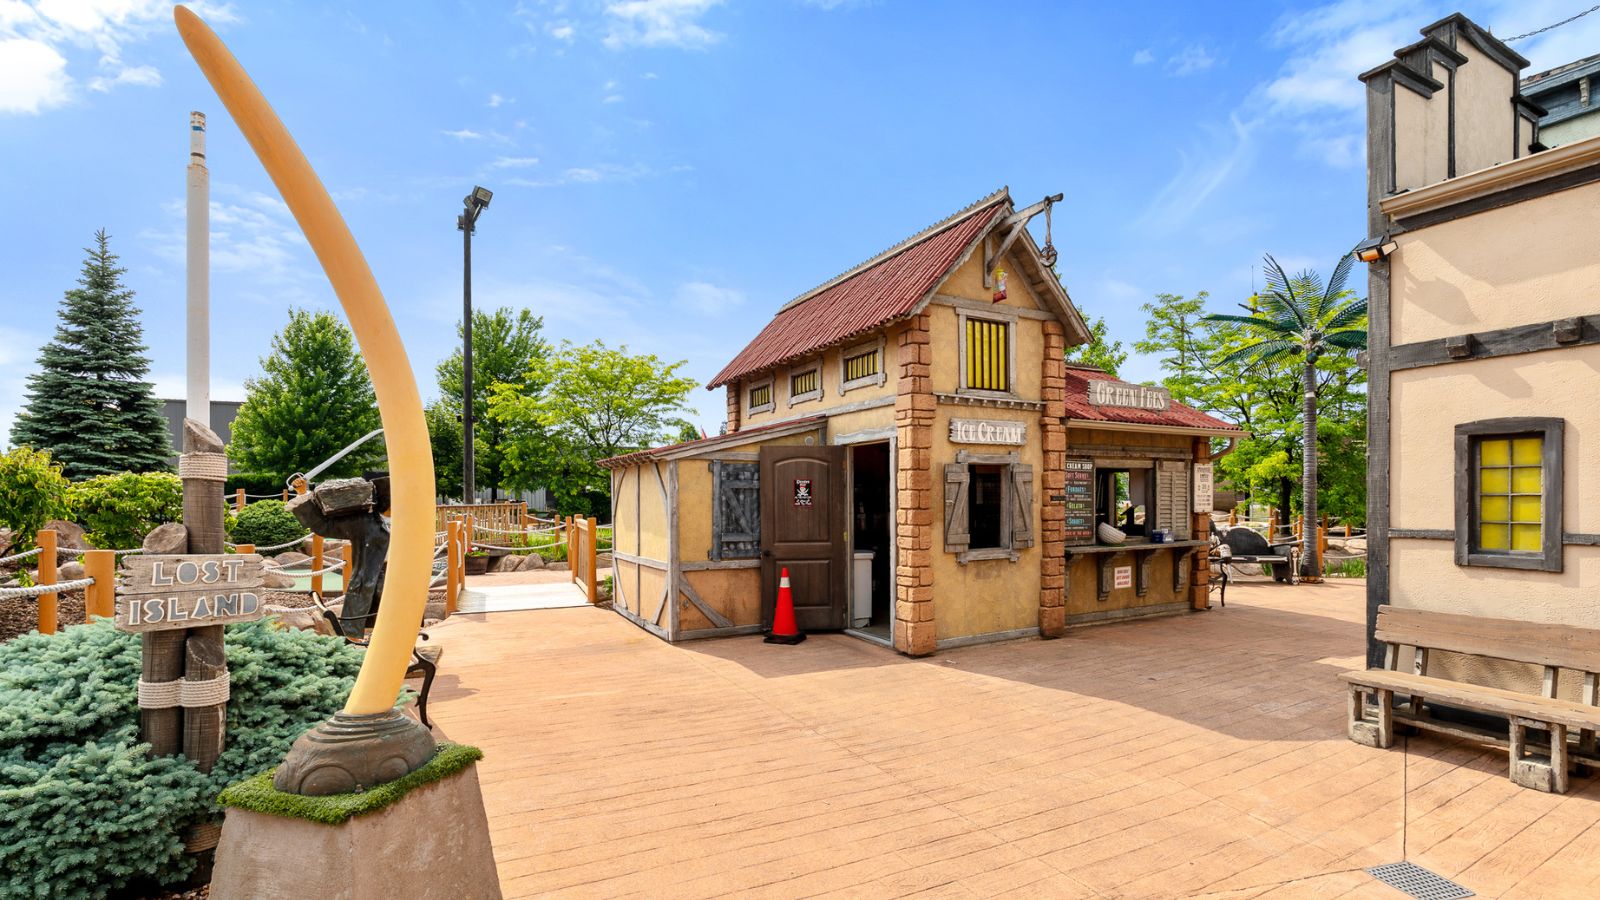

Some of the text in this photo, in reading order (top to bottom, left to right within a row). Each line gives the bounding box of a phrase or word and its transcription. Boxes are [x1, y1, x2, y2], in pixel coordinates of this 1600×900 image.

[1096, 380, 1166, 409] GREEN FEES
[956, 421, 1022, 443] ICE CREAM
[152, 560, 244, 586] LOST
[128, 592, 259, 625] ISLAND
